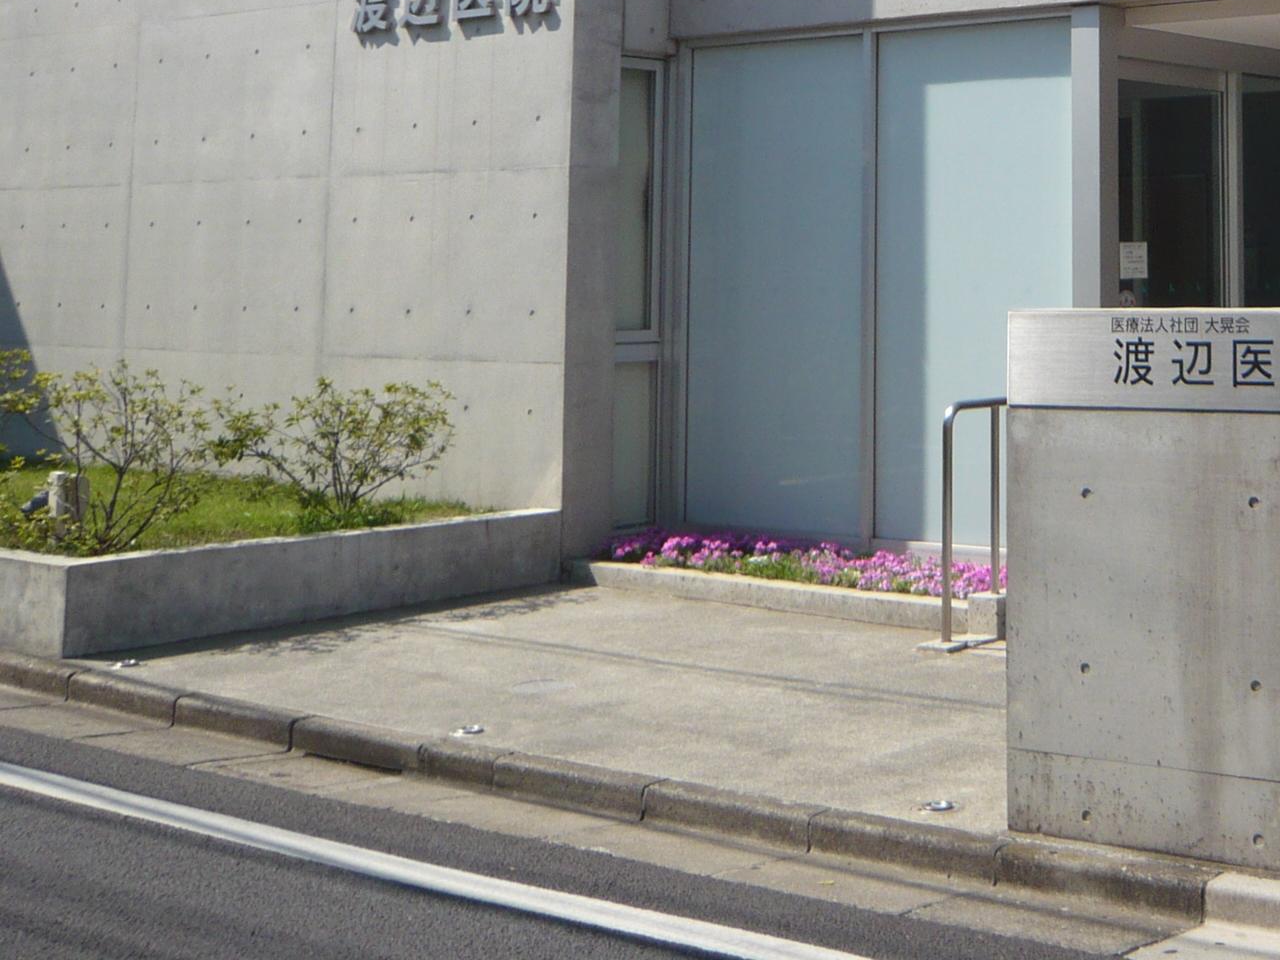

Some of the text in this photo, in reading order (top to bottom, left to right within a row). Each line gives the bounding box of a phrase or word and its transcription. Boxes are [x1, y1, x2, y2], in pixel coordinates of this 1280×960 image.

[1111, 317, 1250, 334] 医療法人社団 大晃会
